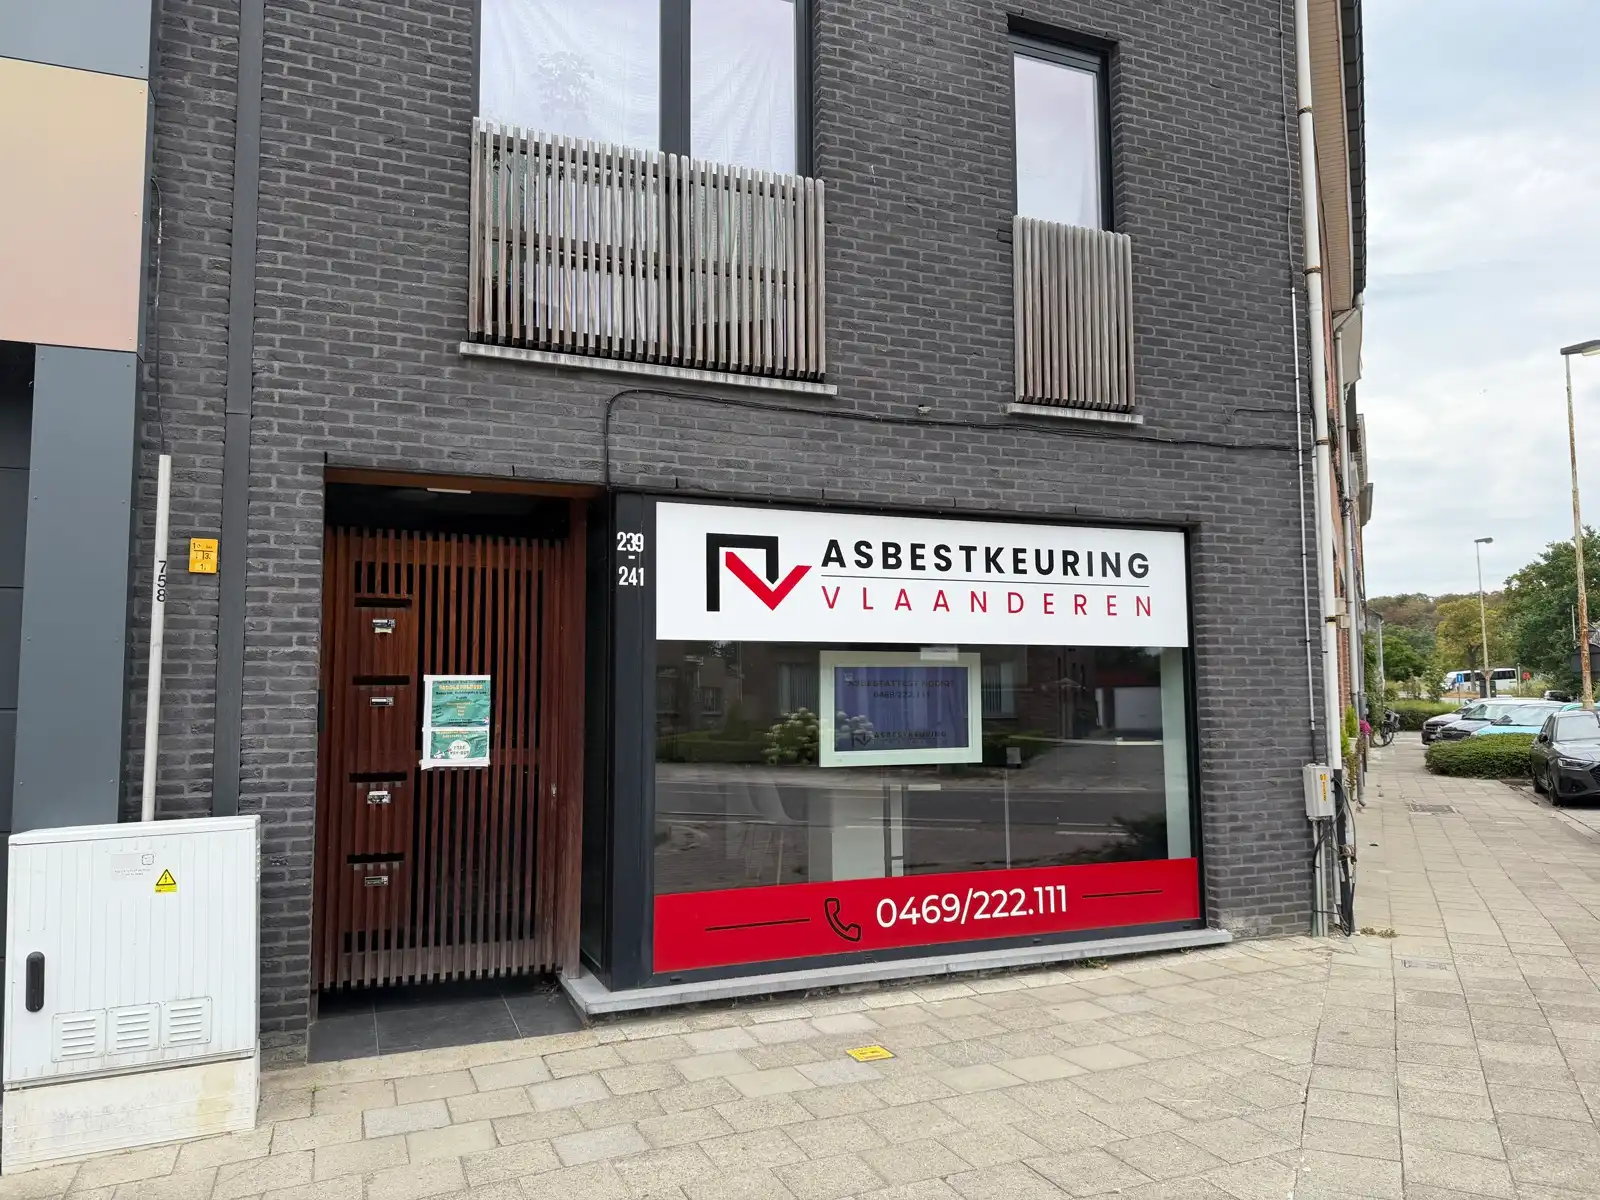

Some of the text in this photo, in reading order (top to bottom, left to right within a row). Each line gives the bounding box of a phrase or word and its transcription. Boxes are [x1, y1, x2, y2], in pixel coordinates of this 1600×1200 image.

[616, 531, 645, 553] 239
[821, 538, 1150, 579] ASBESTKEURING
[156, 561, 167, 602] 758
[618, 565, 645, 587] 241
[821, 586, 1151, 617] VLAANDEREN
[875, 884, 1068, 929] 0469/222.111
